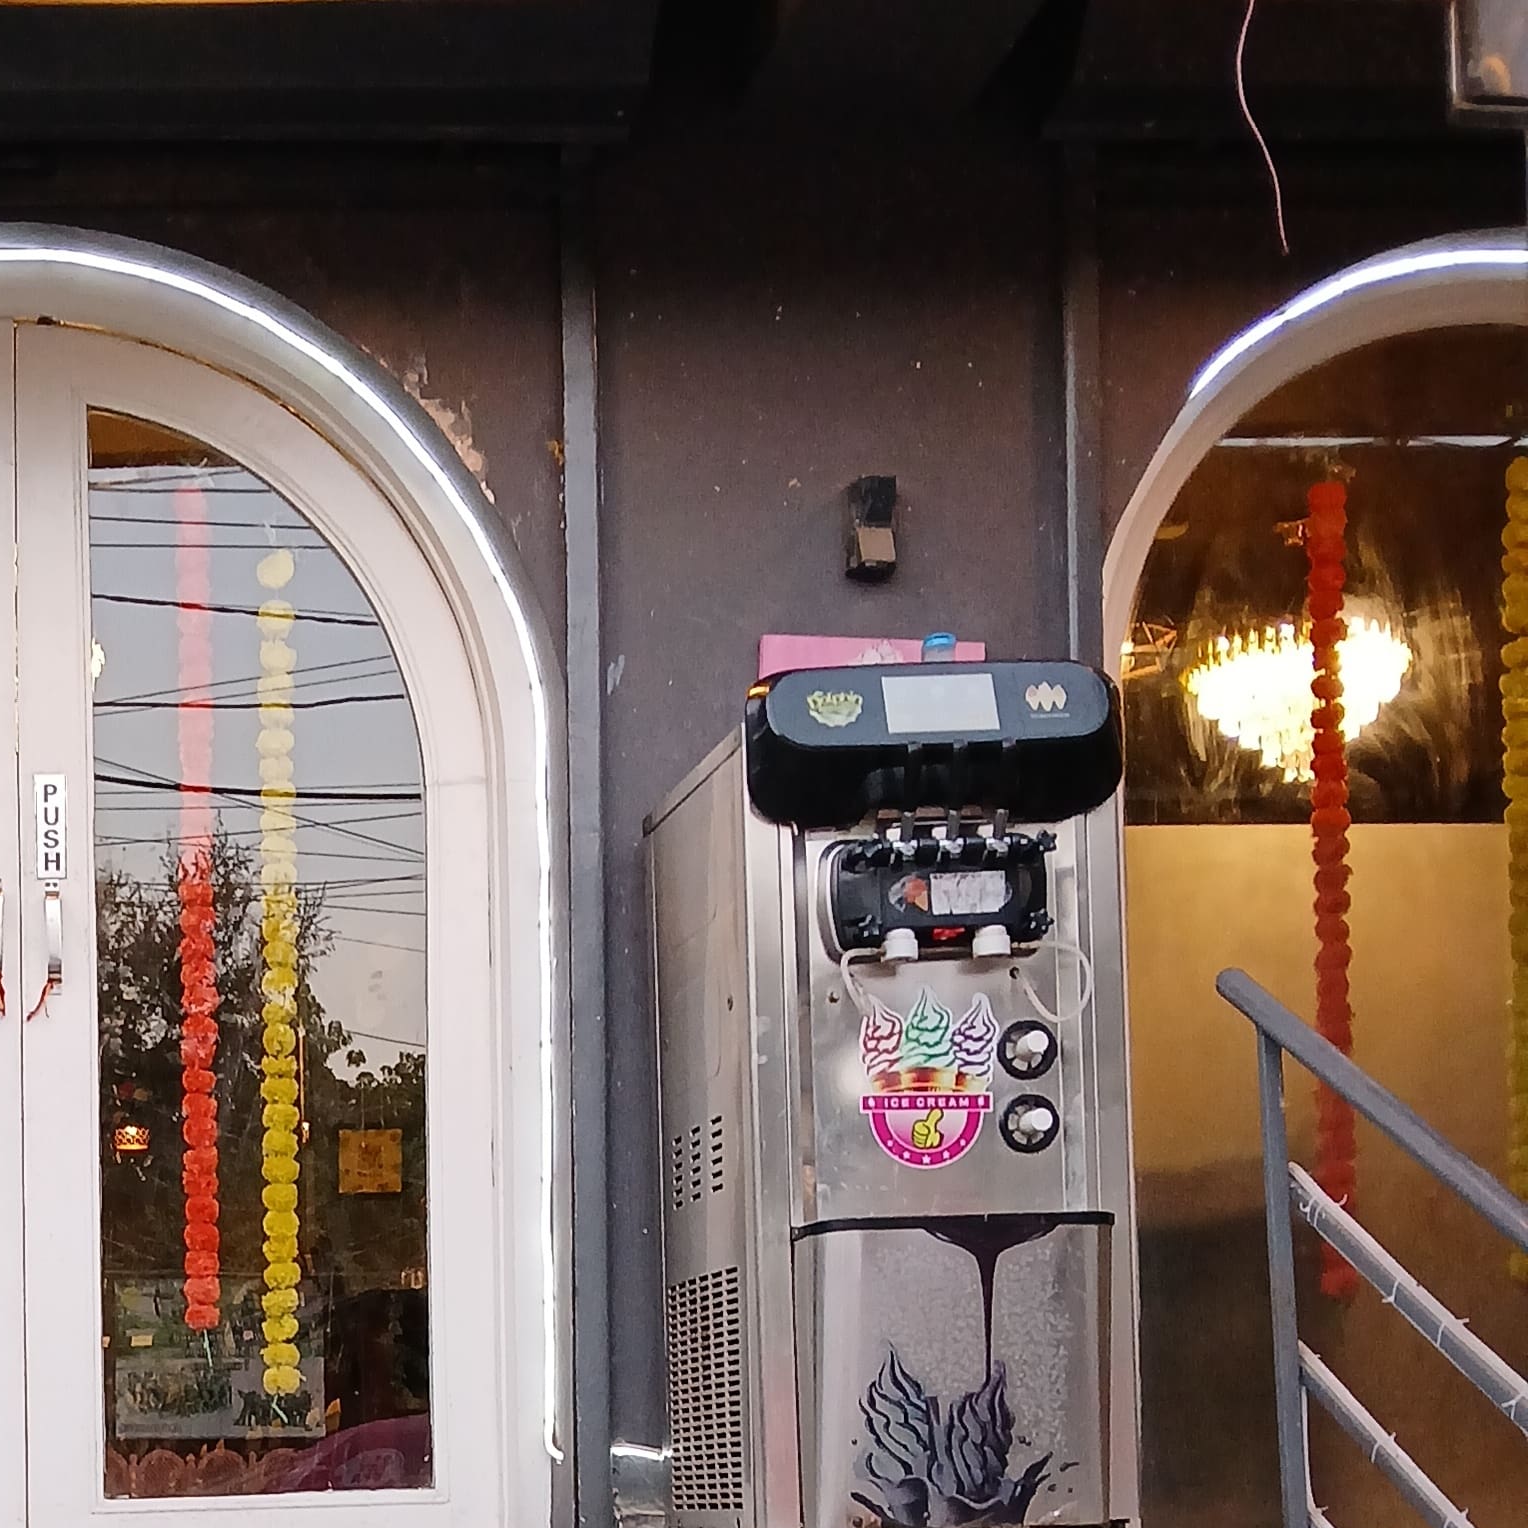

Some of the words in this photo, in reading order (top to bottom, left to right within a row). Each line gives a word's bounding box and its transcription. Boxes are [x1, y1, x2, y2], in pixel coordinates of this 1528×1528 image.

[43, 784, 61, 872] PUSH
[884, 1097, 911, 1108] ICE
[916, 1097, 969, 1108] CREAM
